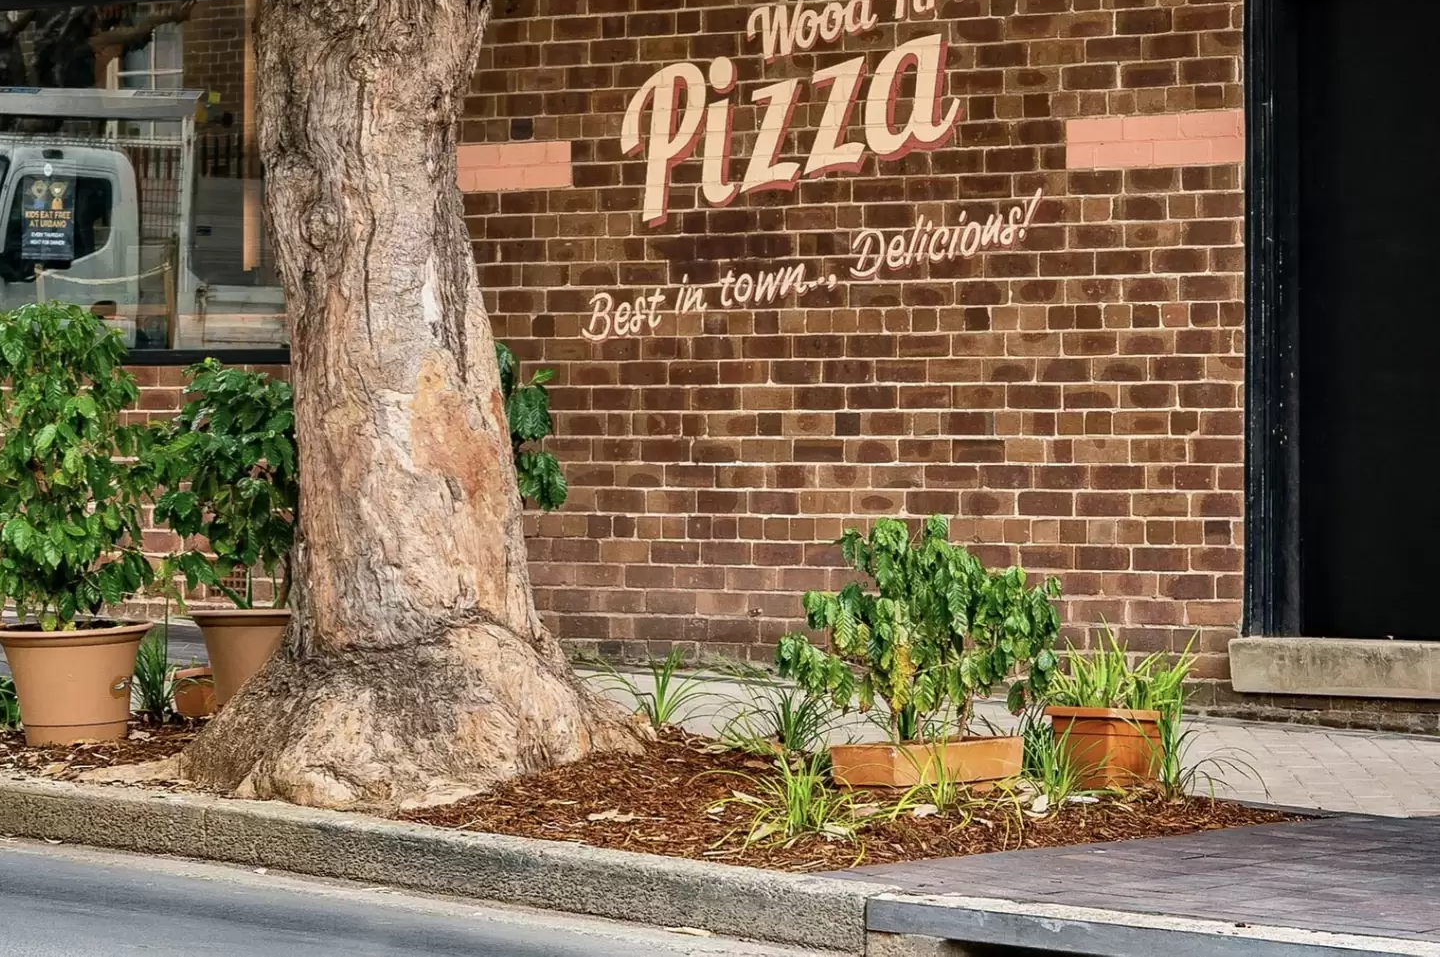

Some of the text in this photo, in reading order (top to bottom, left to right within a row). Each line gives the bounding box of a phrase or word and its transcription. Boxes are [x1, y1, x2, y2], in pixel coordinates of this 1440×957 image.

[621, 33, 963, 226] Pizza
[29, 220, 39, 228] AT
[40, 210, 54, 218] EAT
[582, 290, 664, 342] Best
[674, 274, 708, 315] in
[849, 187, 1044, 280] Delicious!
